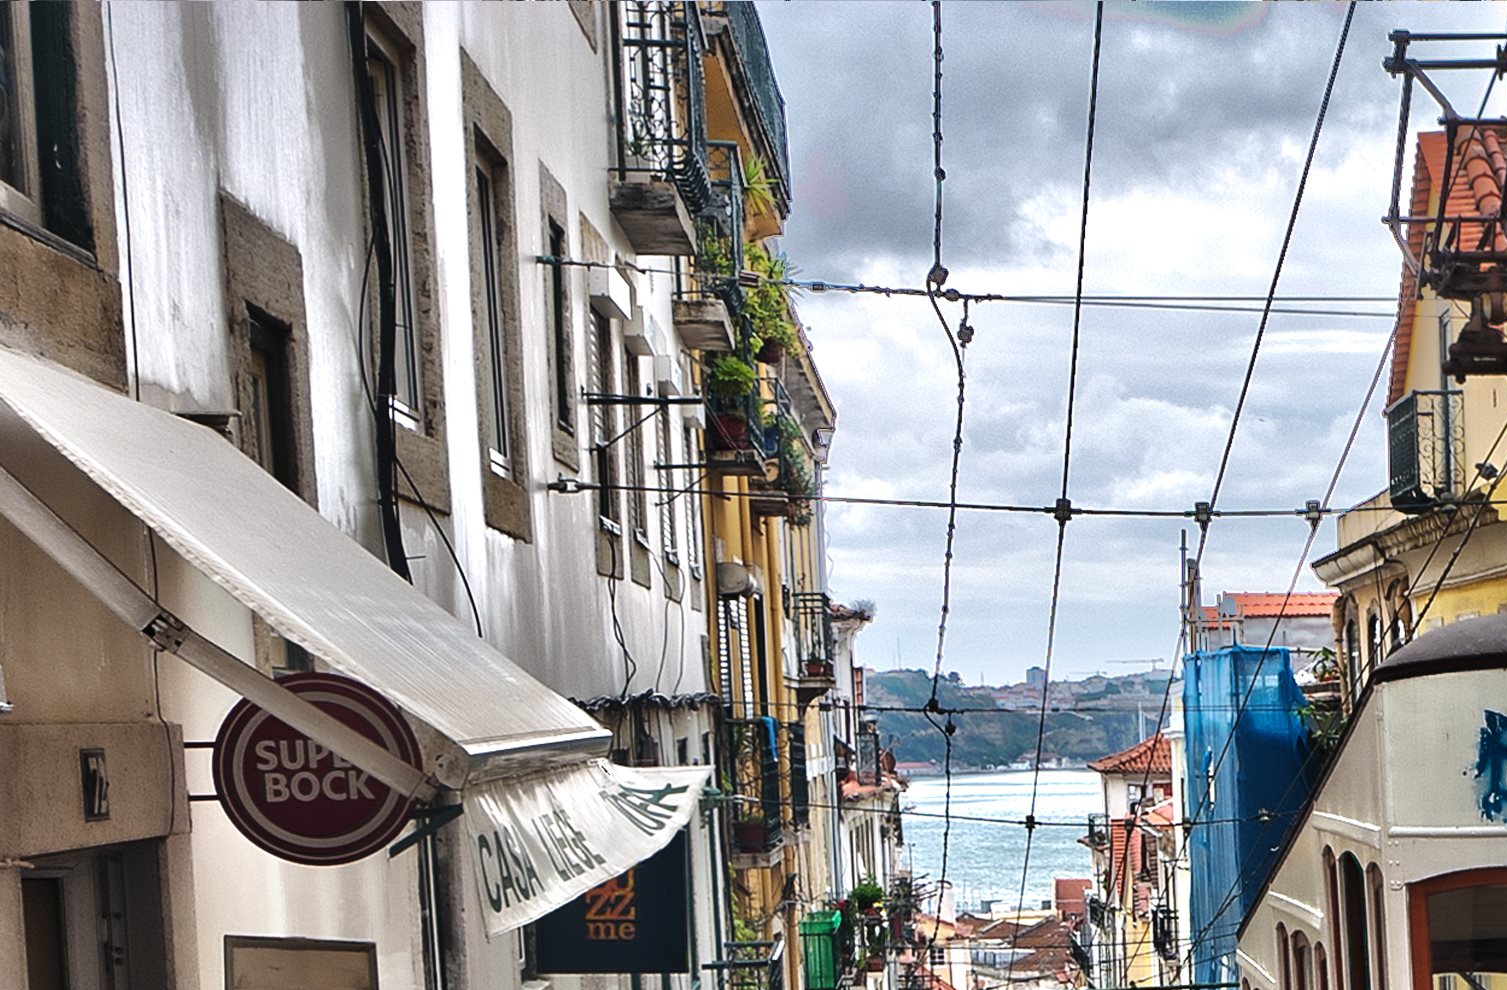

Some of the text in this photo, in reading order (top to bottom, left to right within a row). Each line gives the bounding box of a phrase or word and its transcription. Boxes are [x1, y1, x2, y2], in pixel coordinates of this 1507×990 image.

[264, 770, 376, 803] BOCK
[478, 830, 546, 913] CASA
[585, 921, 637, 940] me
